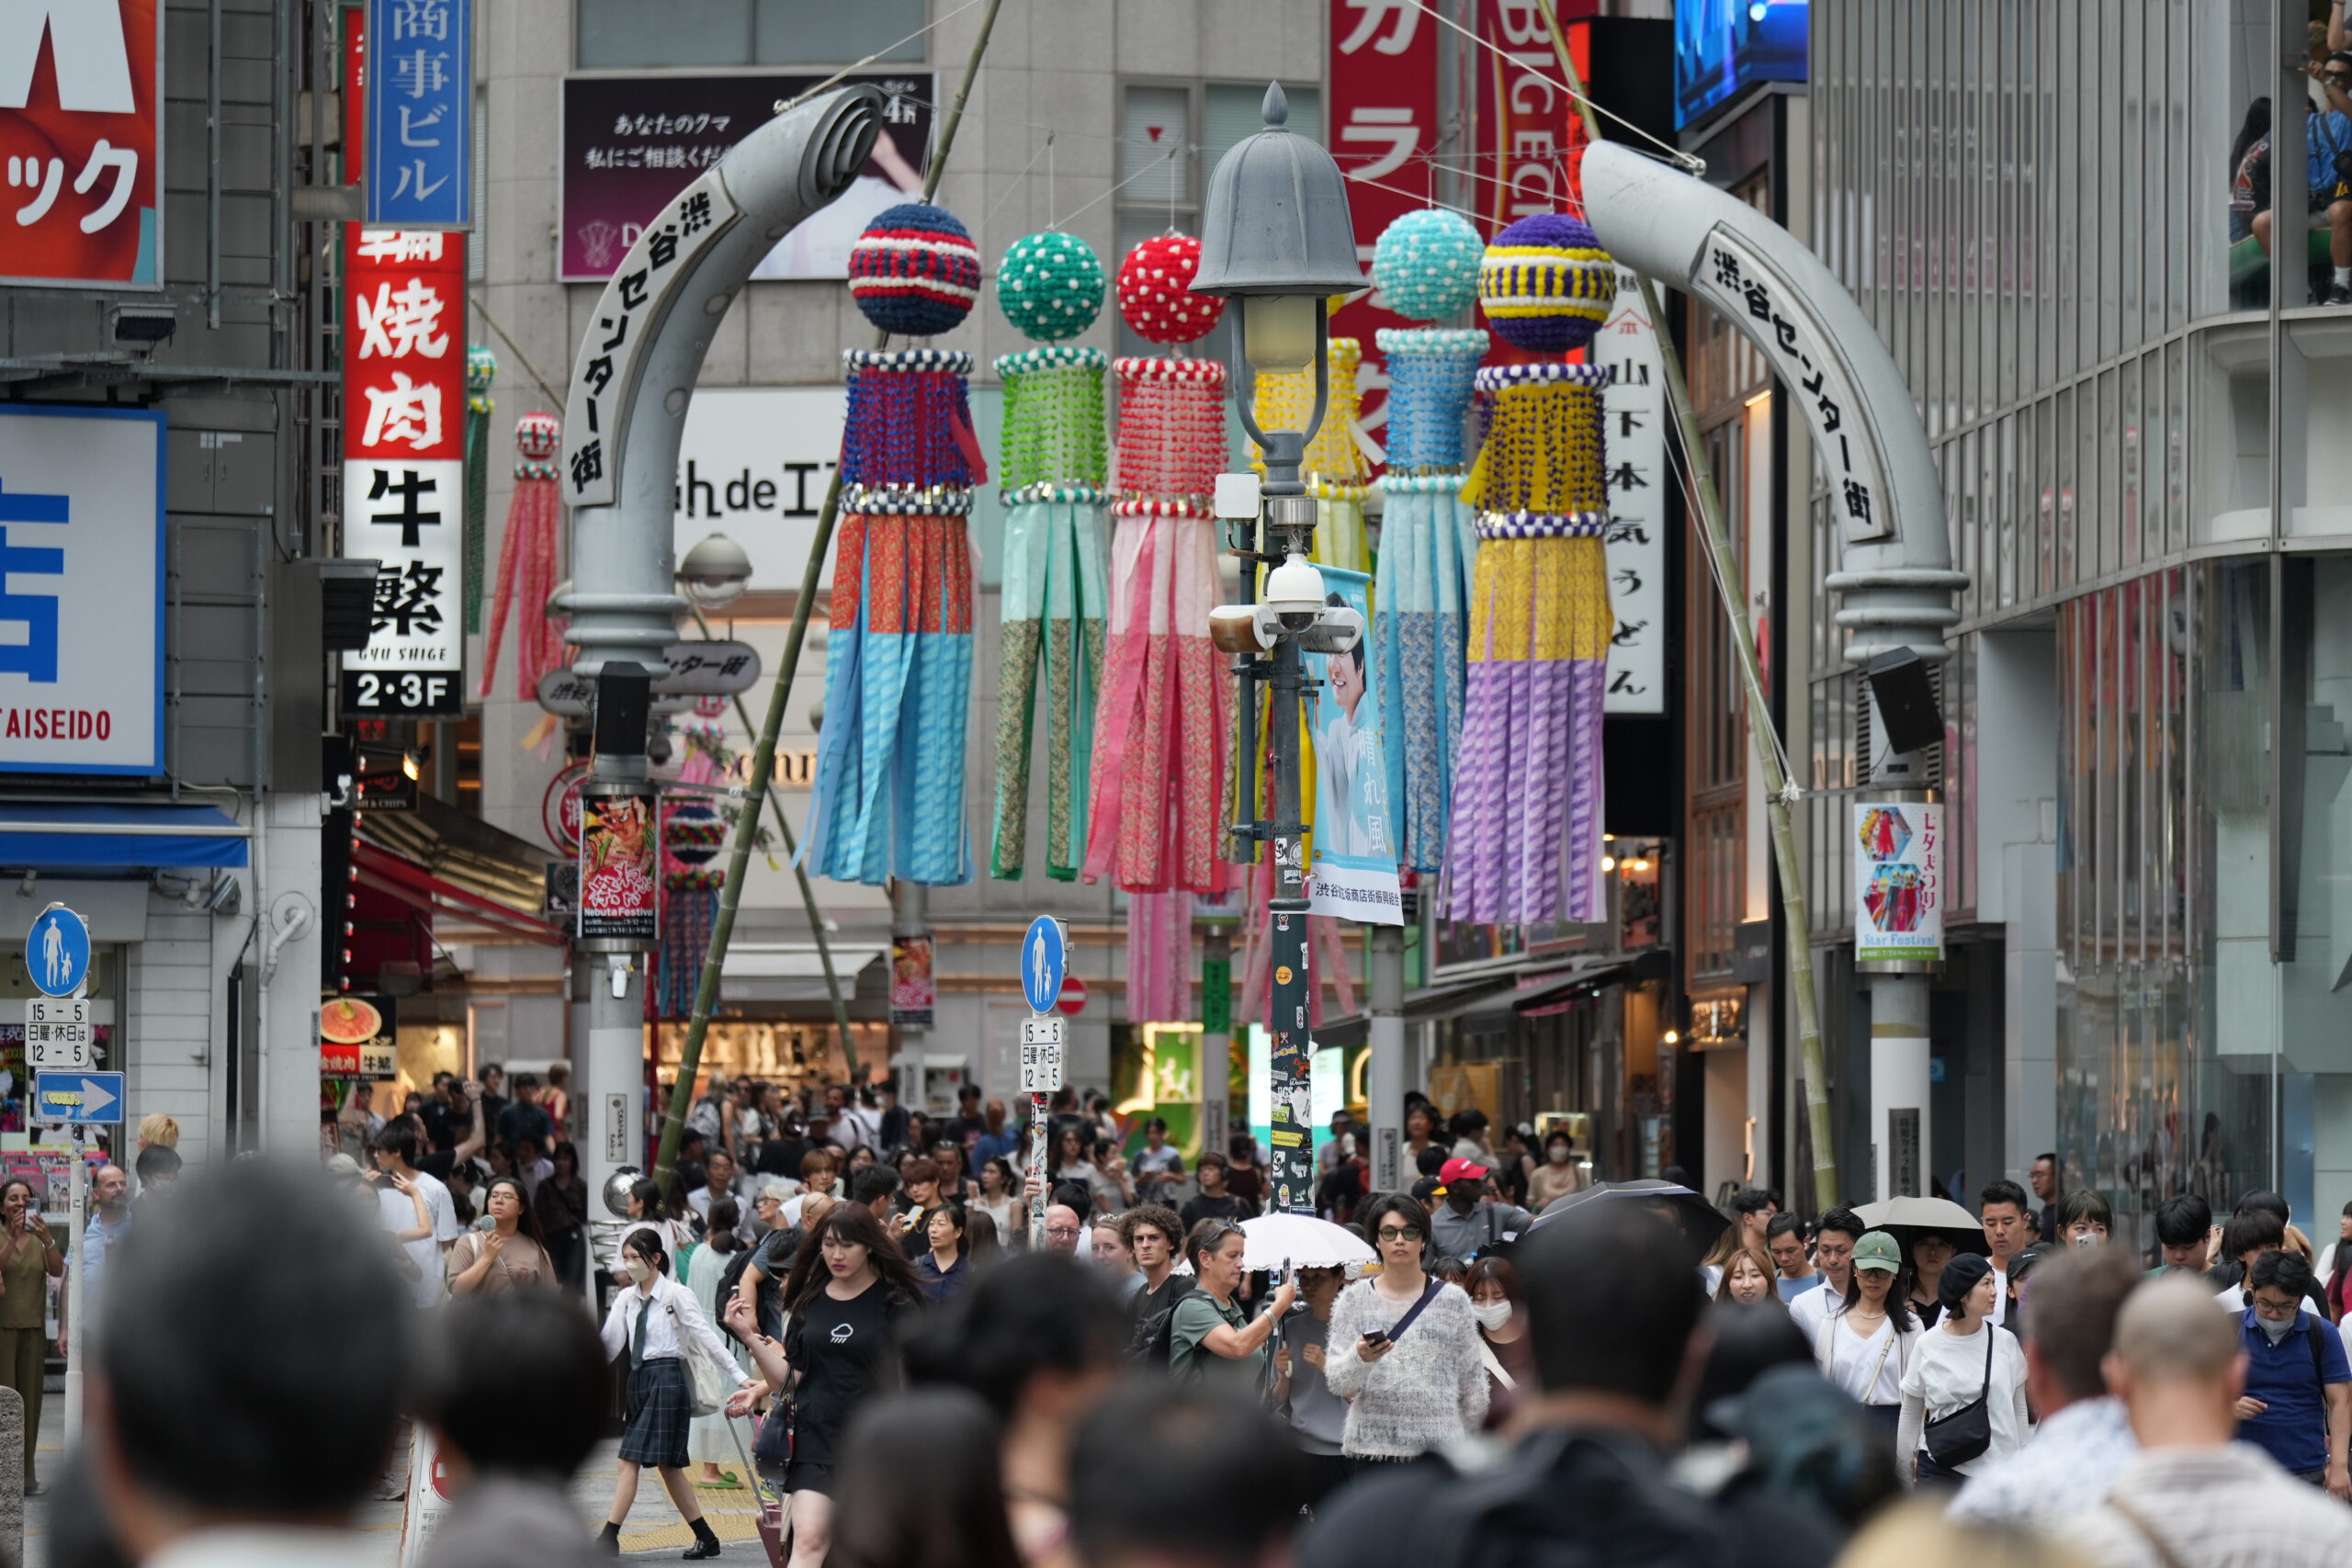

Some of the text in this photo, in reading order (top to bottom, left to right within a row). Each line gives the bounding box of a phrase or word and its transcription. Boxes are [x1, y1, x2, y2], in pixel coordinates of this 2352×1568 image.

[583, 143, 732, 170] 私にご相談くだ
[570, 191, 712, 494] 渋谷センター街
[1713, 248, 1872, 525] 渋谷センター街
[725, 468, 777, 512] de
[1606, 358, 1651, 695] 山下本気うどん
[368, 468, 445, 637] 牛繁
[399, 647, 447, 662] SHIGE
[1358, 728, 1387, 854] 晴れ風
[583, 908, 654, 917] Nebuta Festival
[1864, 933, 1936, 946] Star Festival
[32, 1004, 45, 1021] 15
[74, 1004, 83, 1021] 5
[1025, 1023, 1034, 1042] 15
[1052, 1023, 1058, 1041] 5
[32, 1044, 44, 1062] 12
[74, 1045, 82, 1062] 5
[1025, 1068, 1034, 1088] 12
[1052, 1067, 1057, 1086] 5
